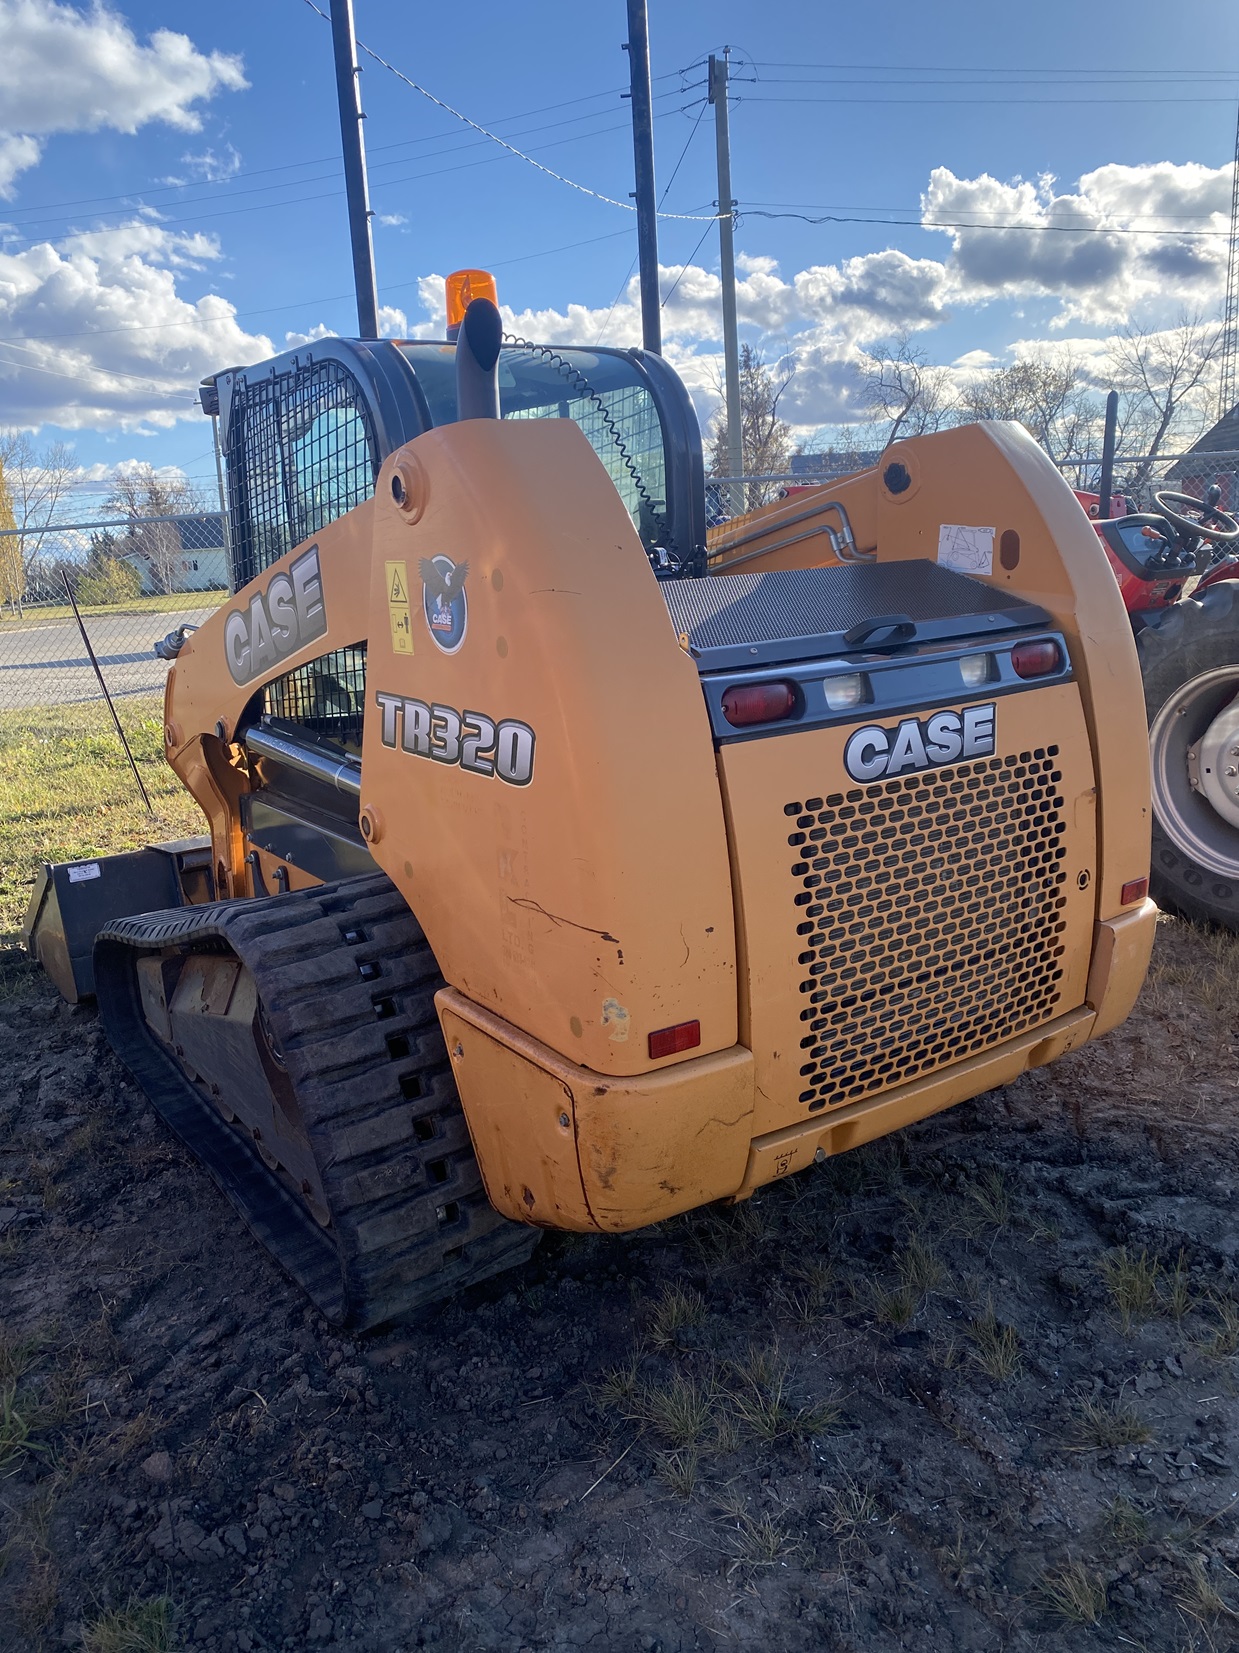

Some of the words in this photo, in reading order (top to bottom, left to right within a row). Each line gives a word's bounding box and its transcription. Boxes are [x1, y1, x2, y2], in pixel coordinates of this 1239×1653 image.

[225, 544, 326, 685] CASE
[432, 614, 452, 625] CASE
[376, 690, 536, 786] TR320
[844, 703, 996, 784] CASE
